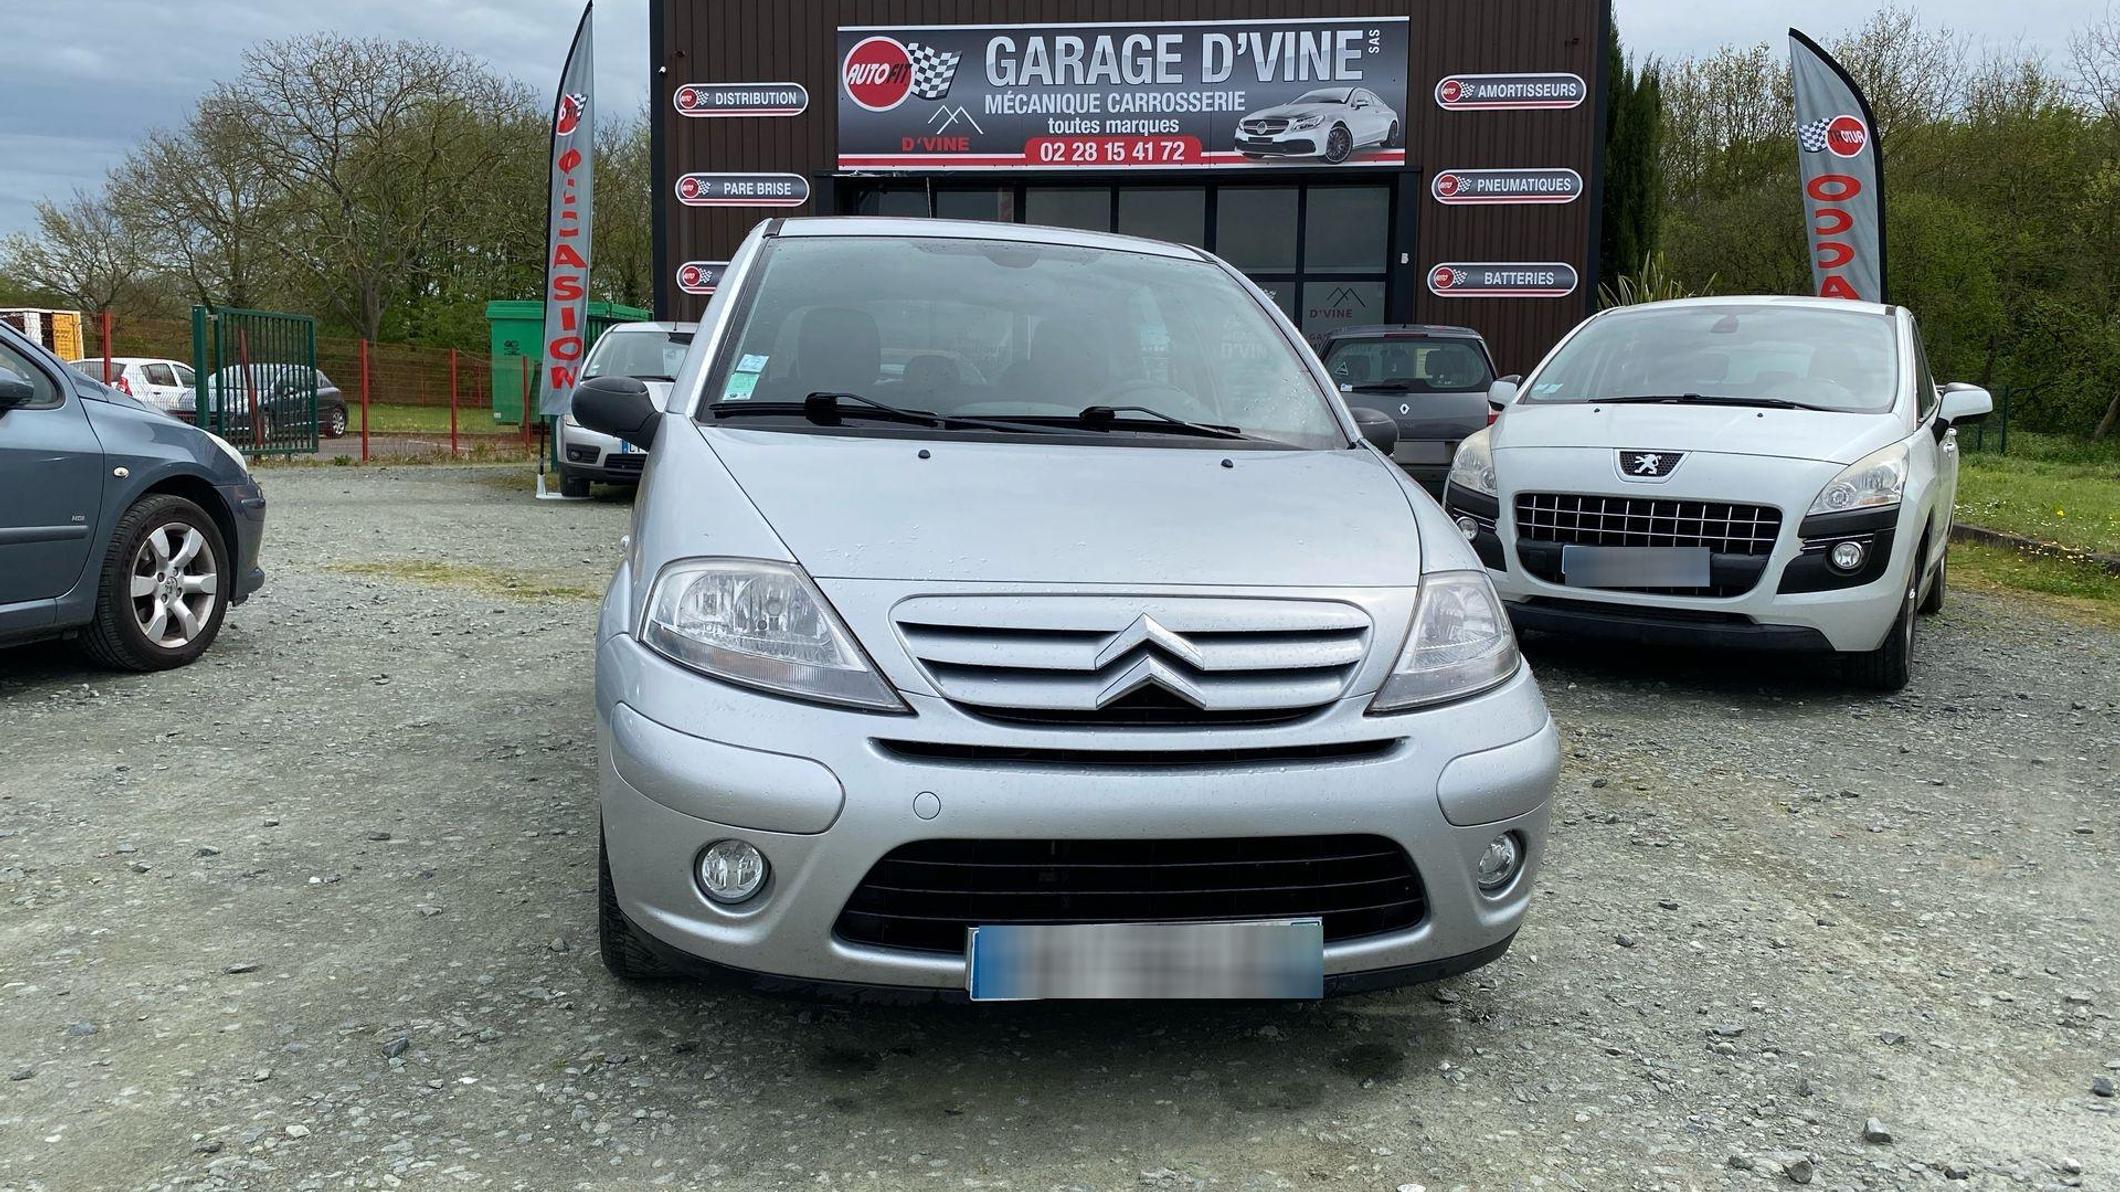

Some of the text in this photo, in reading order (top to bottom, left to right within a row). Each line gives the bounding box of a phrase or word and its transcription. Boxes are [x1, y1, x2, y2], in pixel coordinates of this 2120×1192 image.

[1368, 28, 1381, 54] SAS
[985, 29, 1364, 87] GARAGE D'VINE
[715, 91, 797, 105] DISTRIBUTION
[1478, 83, 1577, 98] AMORTISSEURS
[985, 90, 1246, 115] MÉCANIQUE CARROSSERIE
[1048, 117, 1180, 136] toutes marques
[1040, 140, 1185, 162] 02 28 15 41 72
[724, 182, 792, 196] PARE BRISE
[1477, 177, 1572, 193] PNEUMATIQUES
[1484, 272, 1555, 286] BATTERIES
[1309, 308, 1353, 319] D'VINE
